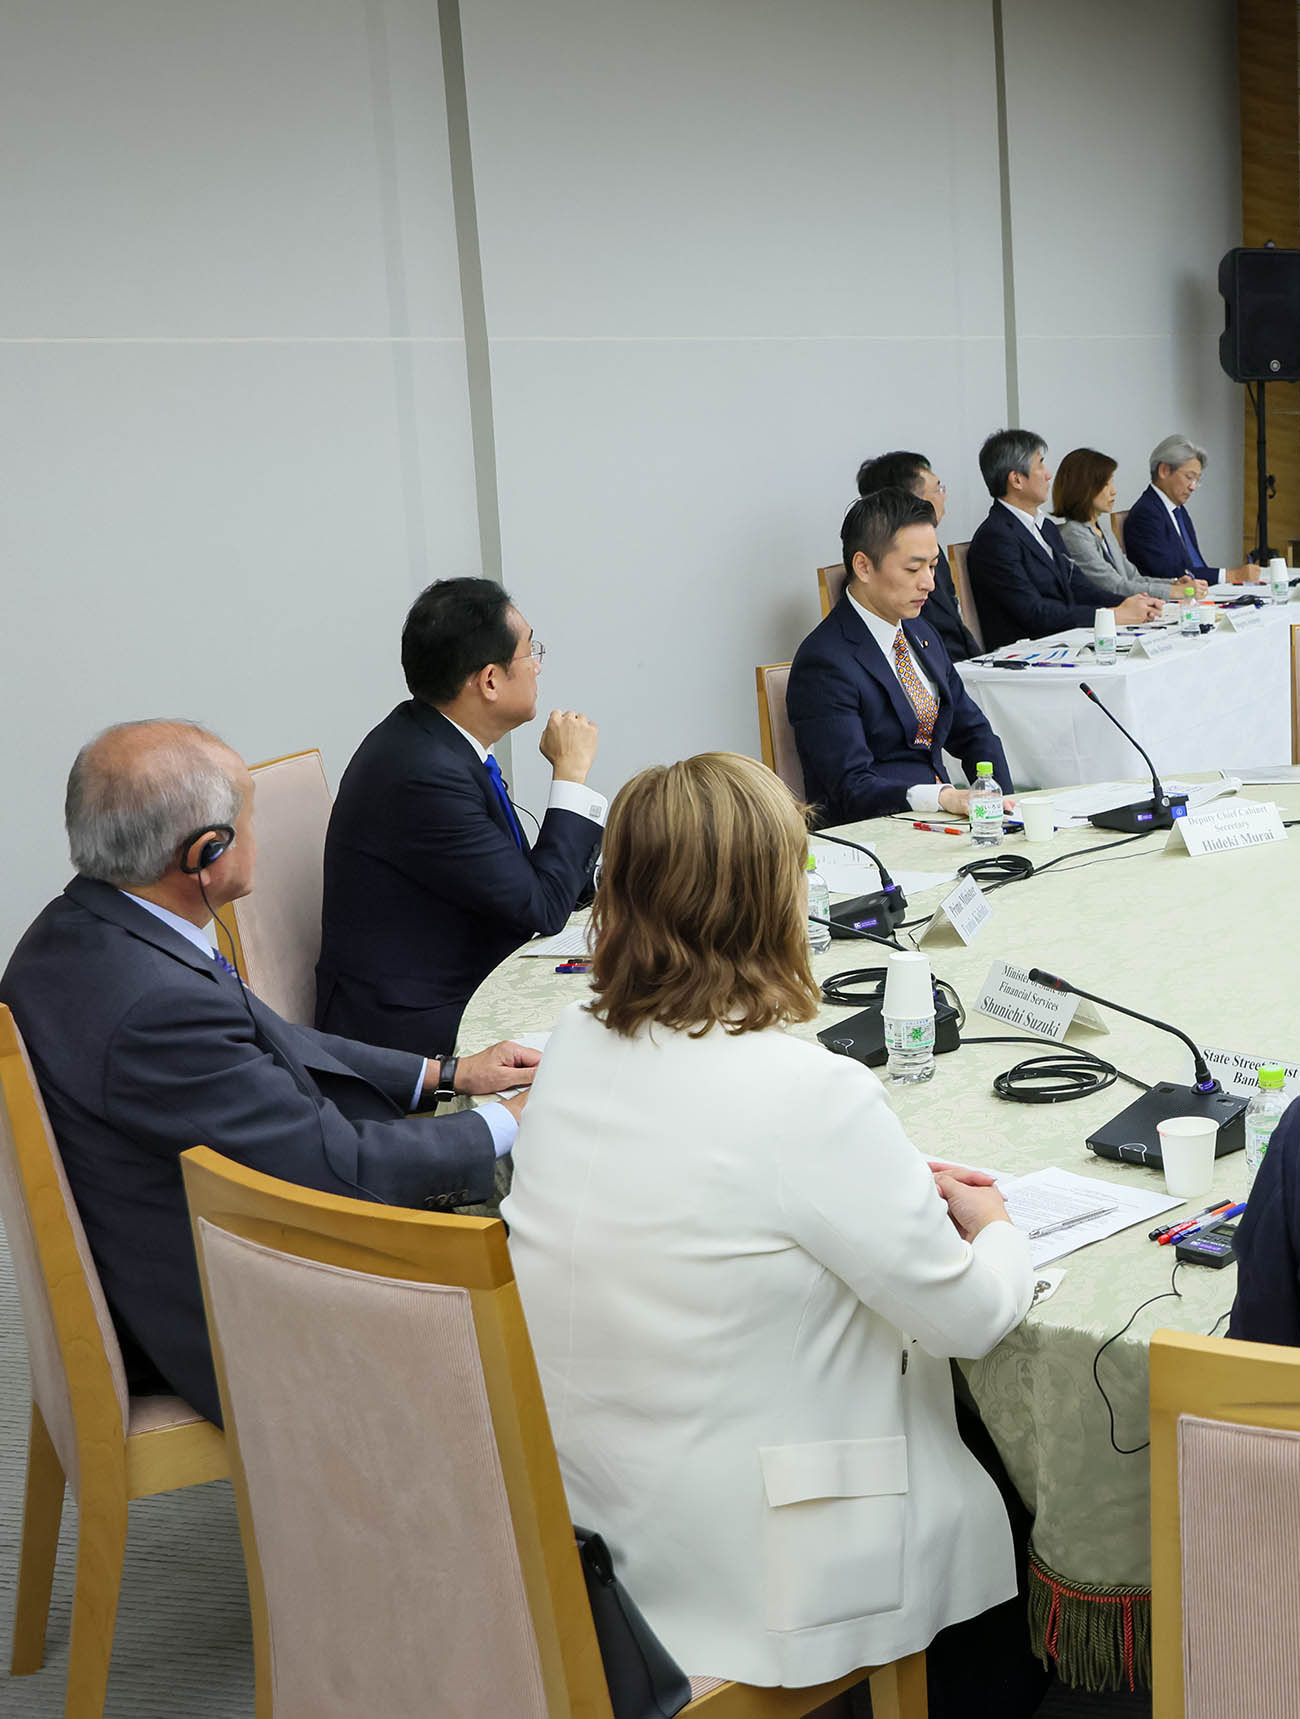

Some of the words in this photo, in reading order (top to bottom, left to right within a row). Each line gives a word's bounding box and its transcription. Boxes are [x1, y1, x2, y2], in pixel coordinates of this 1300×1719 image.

[1187, 814, 1216, 826] Deputy
[1216, 808, 1238, 820] Chief
[1238, 805, 1268, 817] Cabinet
[1214, 820, 1250, 832] Secretary
[1202, 836, 1239, 852] Hideki
[1240, 829, 1275, 845] Murai
[1001, 965, 1030, 984] Minister
[998, 981, 1032, 1001] Financial
[1030, 992, 1058, 1012] Services
[980, 995, 1026, 1024] Shunichi
[1023, 1011, 1061, 1038] Suzuki
[1202, 1048, 1230, 1065] State
